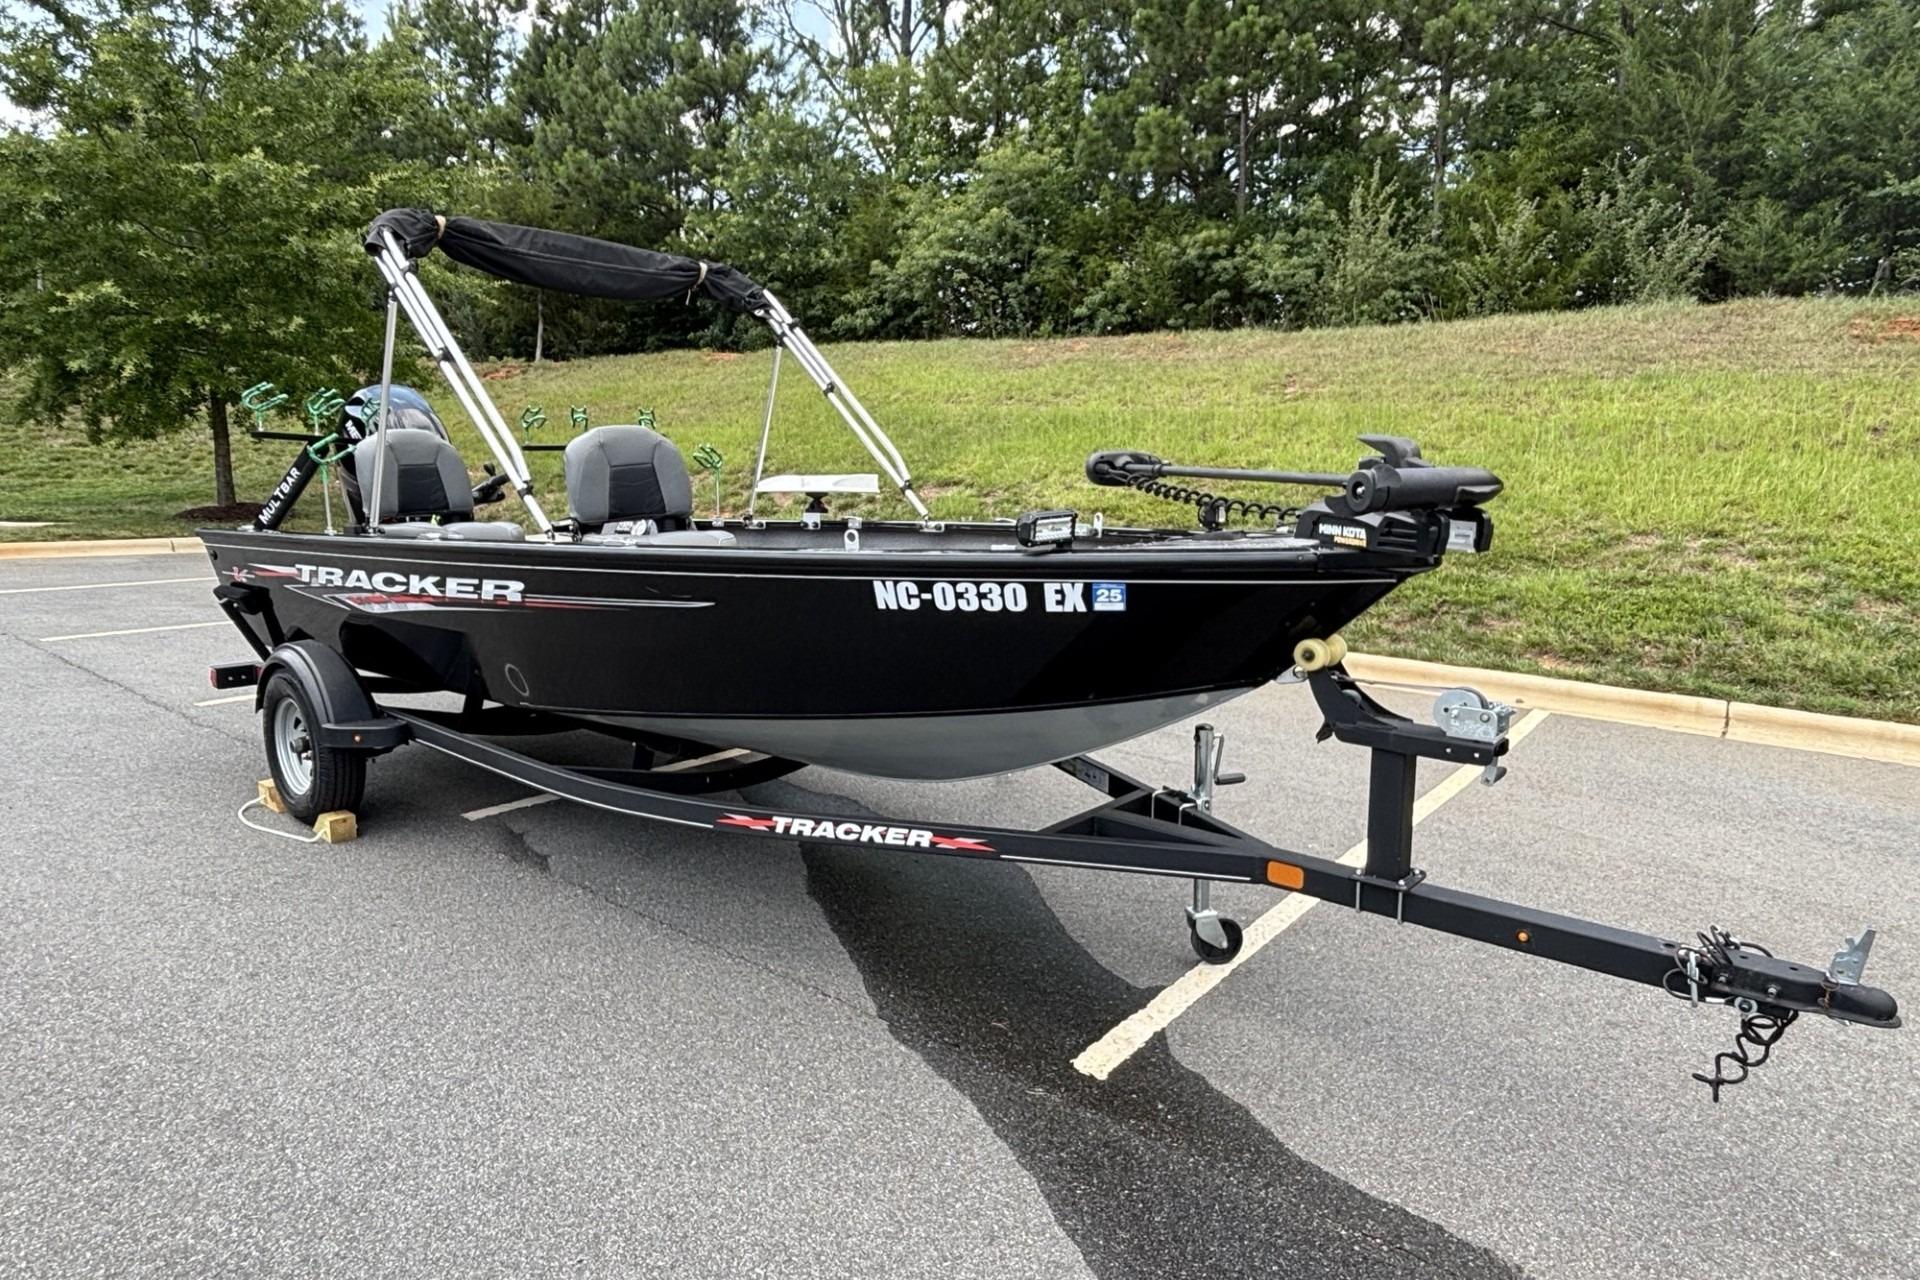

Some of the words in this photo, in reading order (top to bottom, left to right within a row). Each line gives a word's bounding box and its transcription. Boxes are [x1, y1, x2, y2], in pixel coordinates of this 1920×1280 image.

[1318, 523, 1342, 537] MINN
[1342, 525, 1367, 539] KOTA
[295, 564, 525, 602] TRACKER
[873, 580, 1028, 612] NC-0330
[1043, 583, 1087, 612] EX
[1096, 589, 1123, 602] 25
[772, 816, 933, 847] TRACKER
